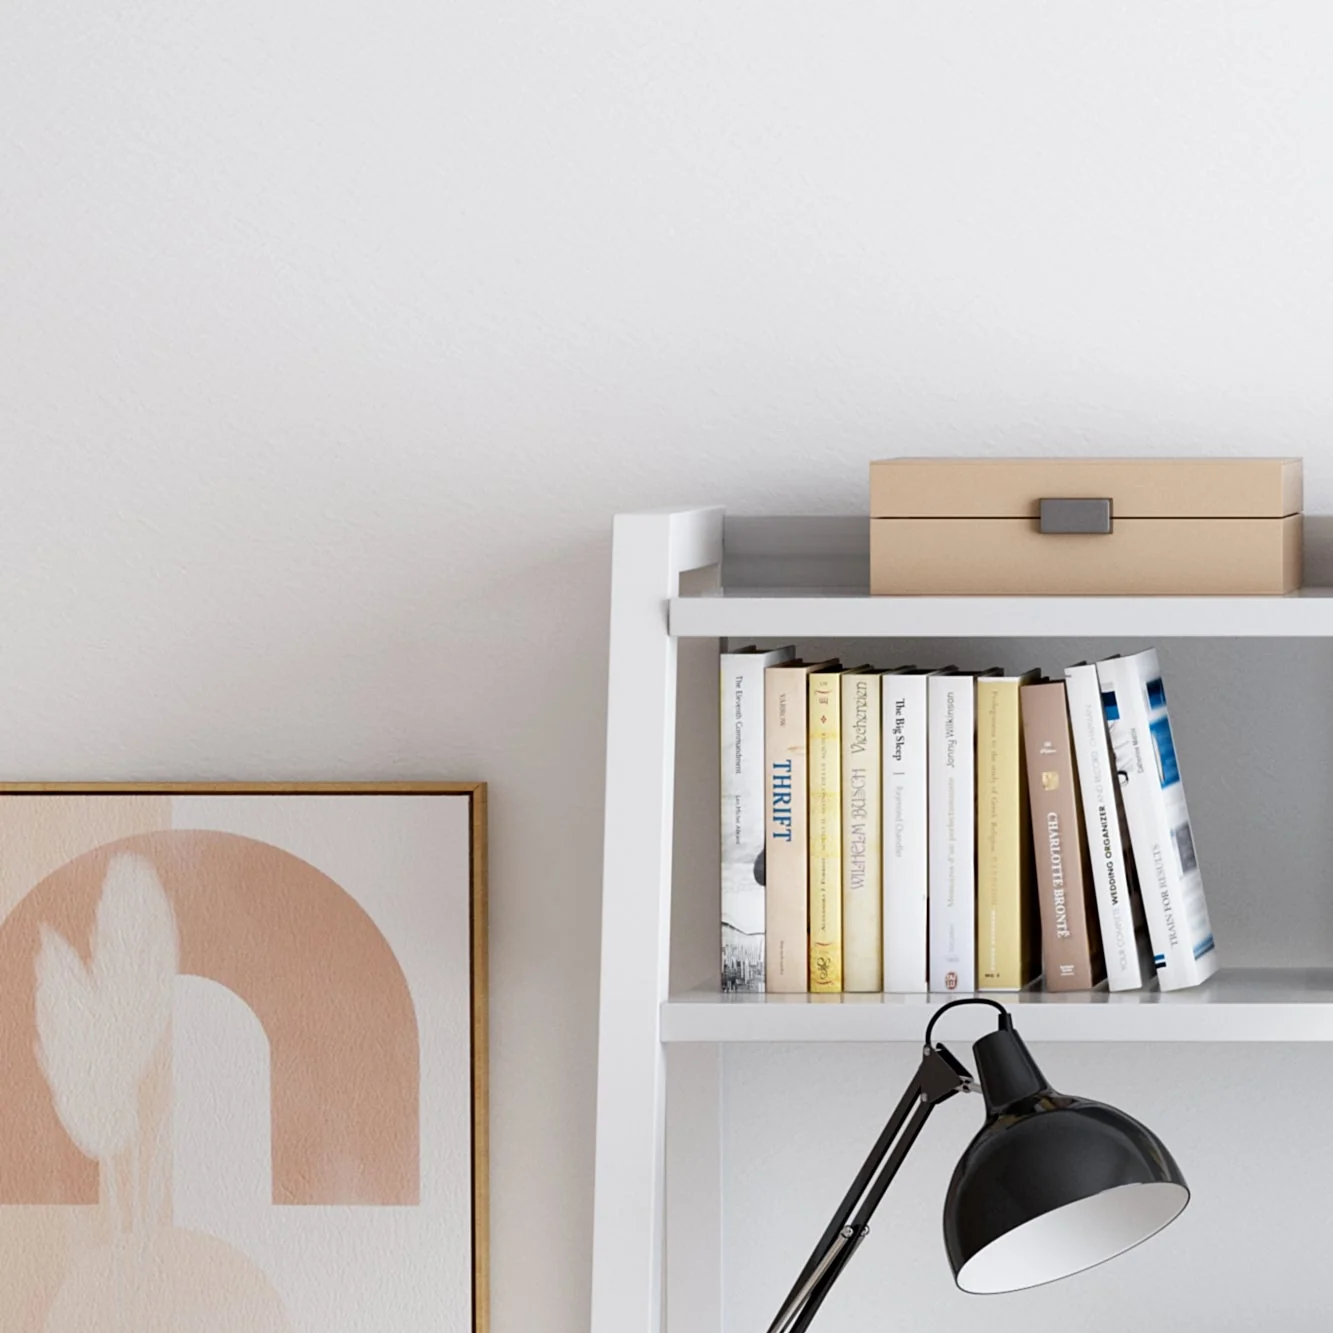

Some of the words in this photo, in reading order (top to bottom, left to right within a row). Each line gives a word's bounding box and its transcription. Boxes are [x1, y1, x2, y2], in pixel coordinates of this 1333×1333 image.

[851, 682, 867, 753] Viechereien
[893, 718, 904, 734] Big
[896, 699, 904, 715] The
[946, 692, 954, 738] Wilkinson
[893, 736, 904, 761] Sleep
[946, 740, 957, 768] Jonny
[773, 760, 791, 841] THRIFT
[851, 769, 867, 818] BUSCH
[895, 786, 905, 822] Raymond
[895, 823, 903, 857] Chandler
[1048, 812, 1063, 886] CHARLOTTE
[1099, 806, 1112, 858] ORGANIZER
[850, 824, 865, 889] WILHELM
[1153, 844, 1167, 888] RESULTS
[1107, 861, 1118, 905] WEDDING
[1161, 890, 1171, 912] FOR
[1054, 889, 1070, 937] BRONTË
[1166, 914, 1178, 946] TRAIN
